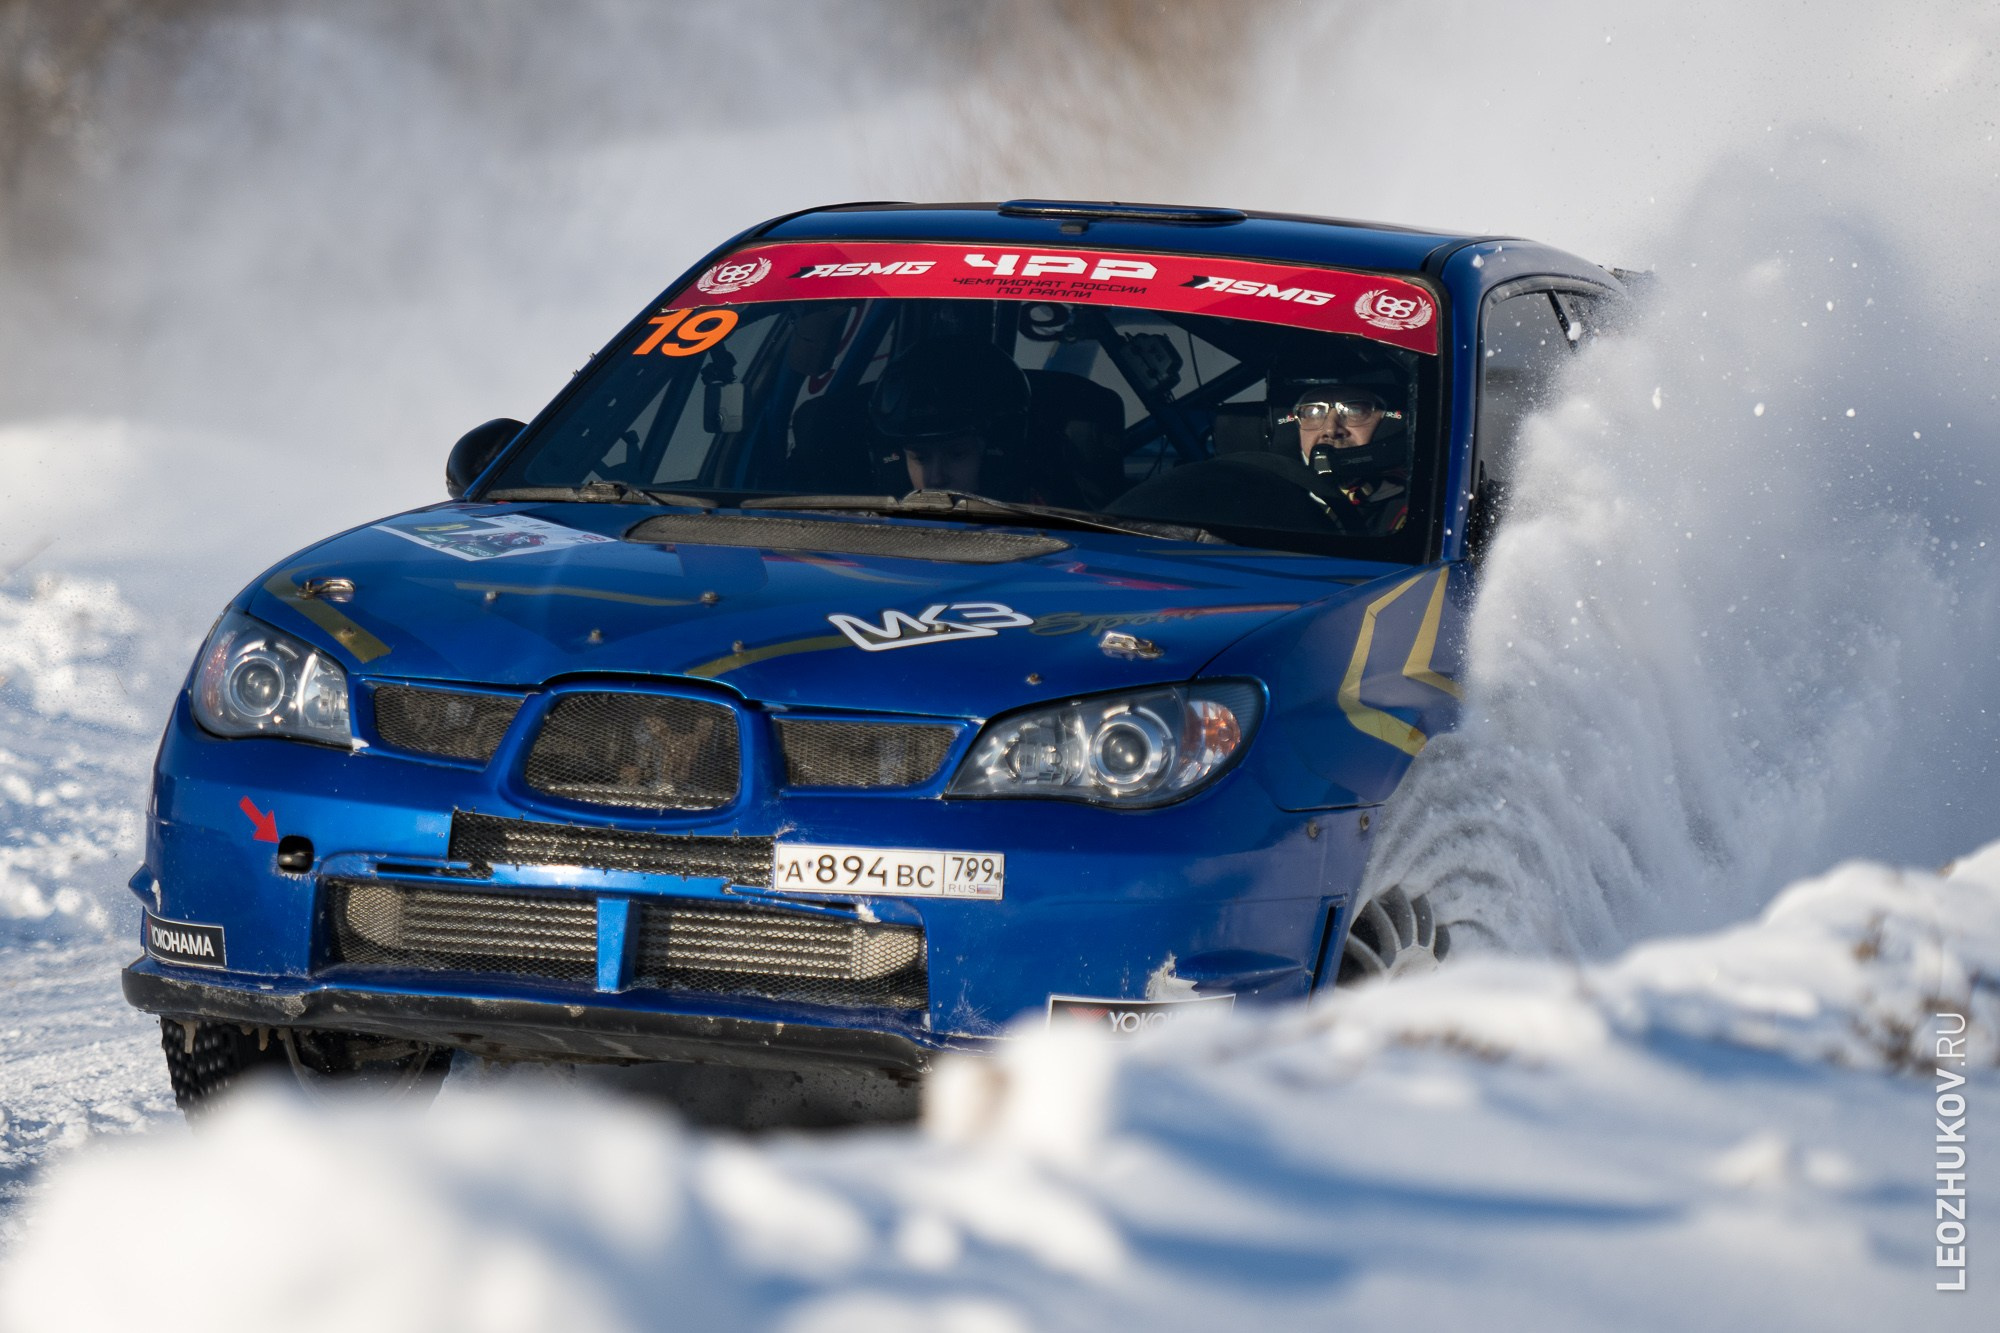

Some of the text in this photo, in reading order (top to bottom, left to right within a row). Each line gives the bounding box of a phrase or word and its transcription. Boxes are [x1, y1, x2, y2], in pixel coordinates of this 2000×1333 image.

[798, 261, 937, 279] ASMG
[952, 277, 1148, 294] ЧЕМПИОНАТ РОССИИ
[996, 286, 1093, 298] ПО РАЛЛИ
[1193, 276, 1337, 306] ASMG
[632, 308, 739, 357] 19
[951, 856, 995, 883] 799
[948, 883, 976, 894] RUS
